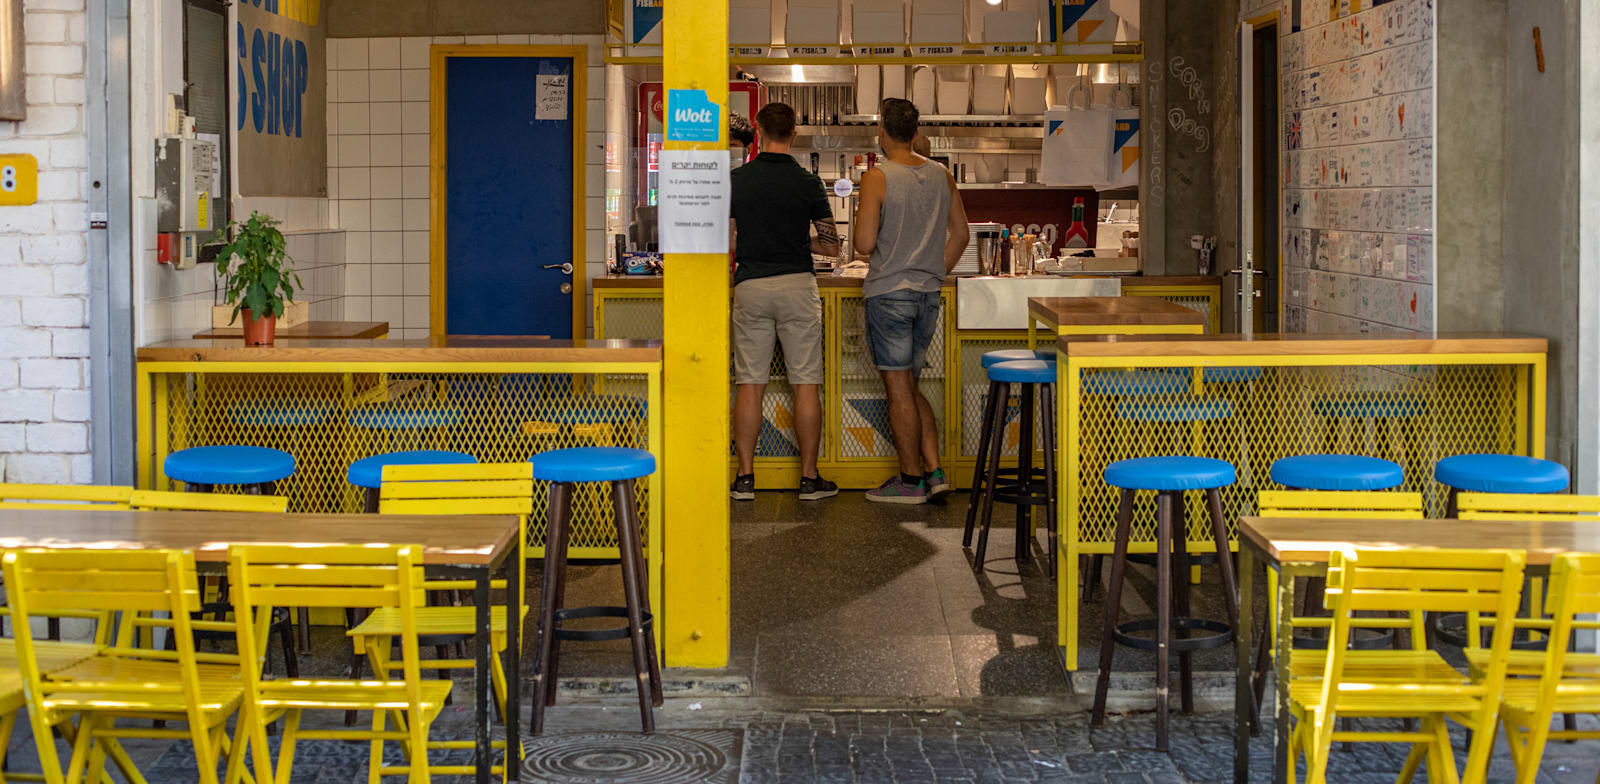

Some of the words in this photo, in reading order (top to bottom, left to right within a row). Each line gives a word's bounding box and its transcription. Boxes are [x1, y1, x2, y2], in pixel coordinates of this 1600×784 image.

[252, 28, 308, 138] SHOP
[675, 107, 713, 123] Wolt
[1148, 61, 1163, 207] SNICKERS
[1, 165, 17, 192] 8
